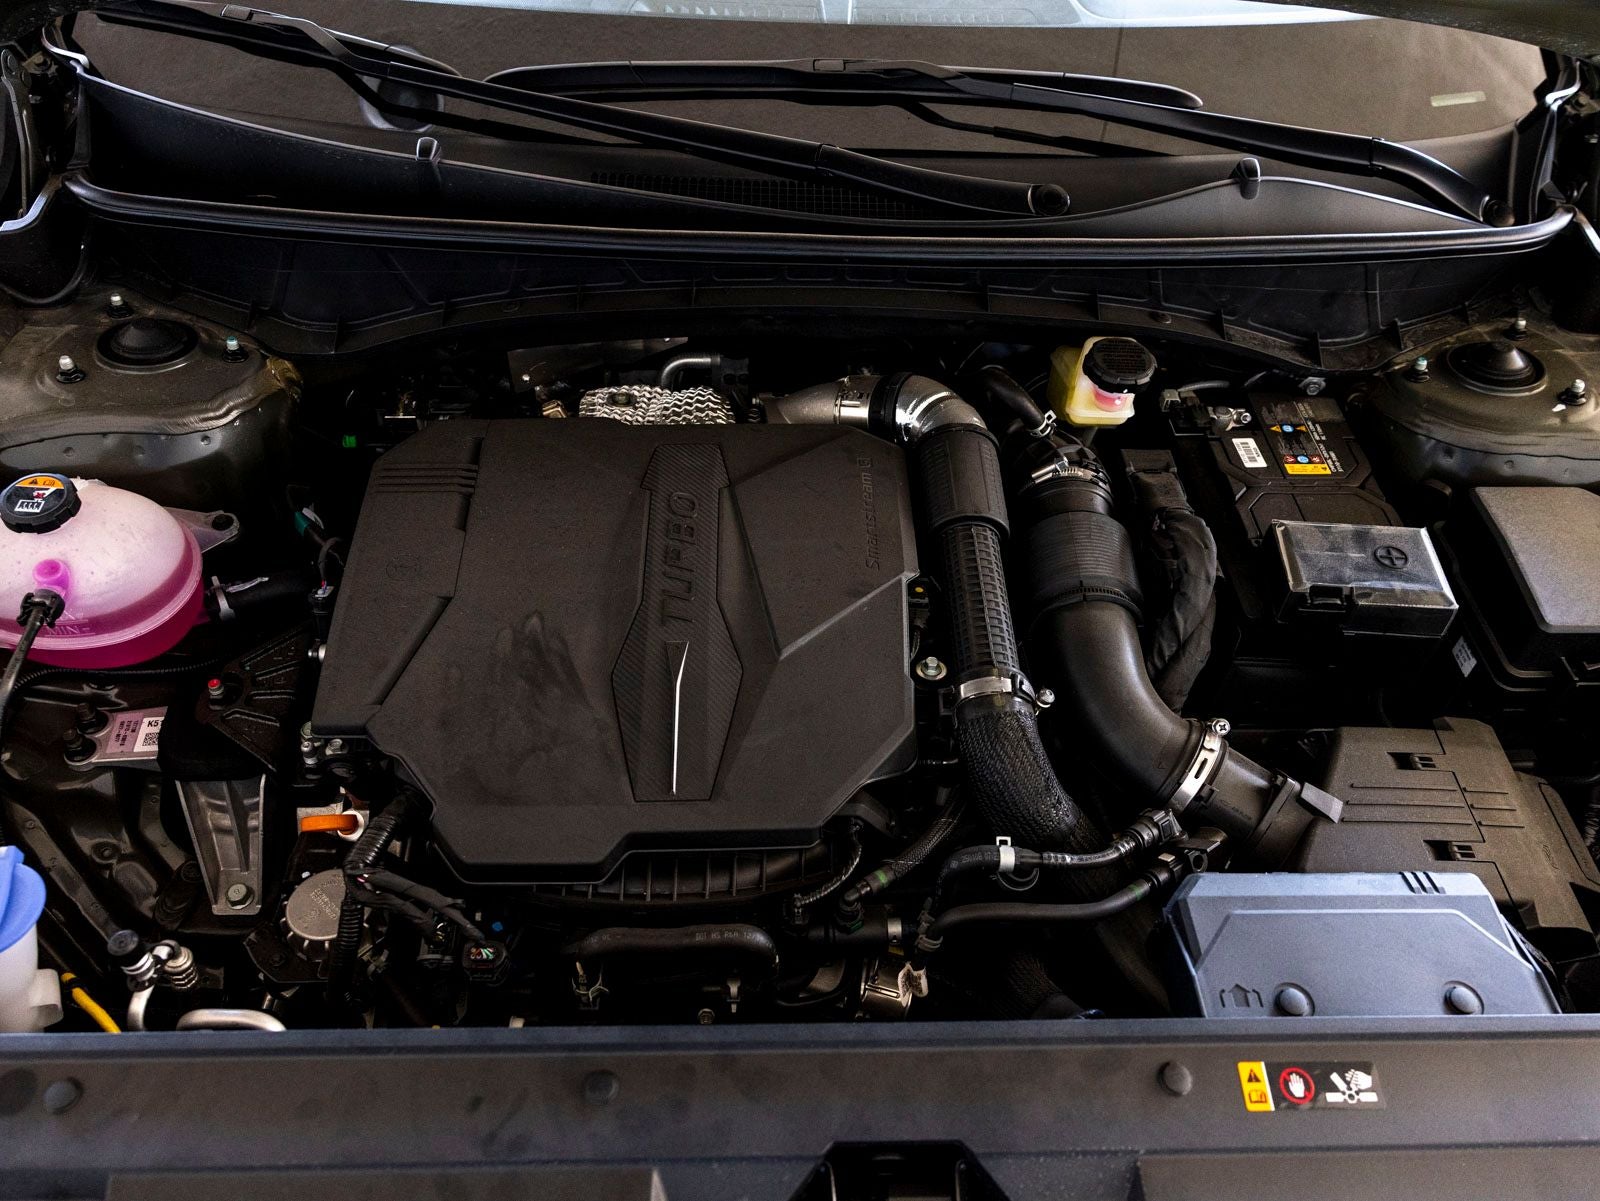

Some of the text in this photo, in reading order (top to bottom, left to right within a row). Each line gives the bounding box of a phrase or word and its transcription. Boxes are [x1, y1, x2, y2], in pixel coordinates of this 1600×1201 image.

[660, 490, 699, 625] TURBO
[859, 472, 880, 571] Smartstream
[147, 719, 163, 728] K5
